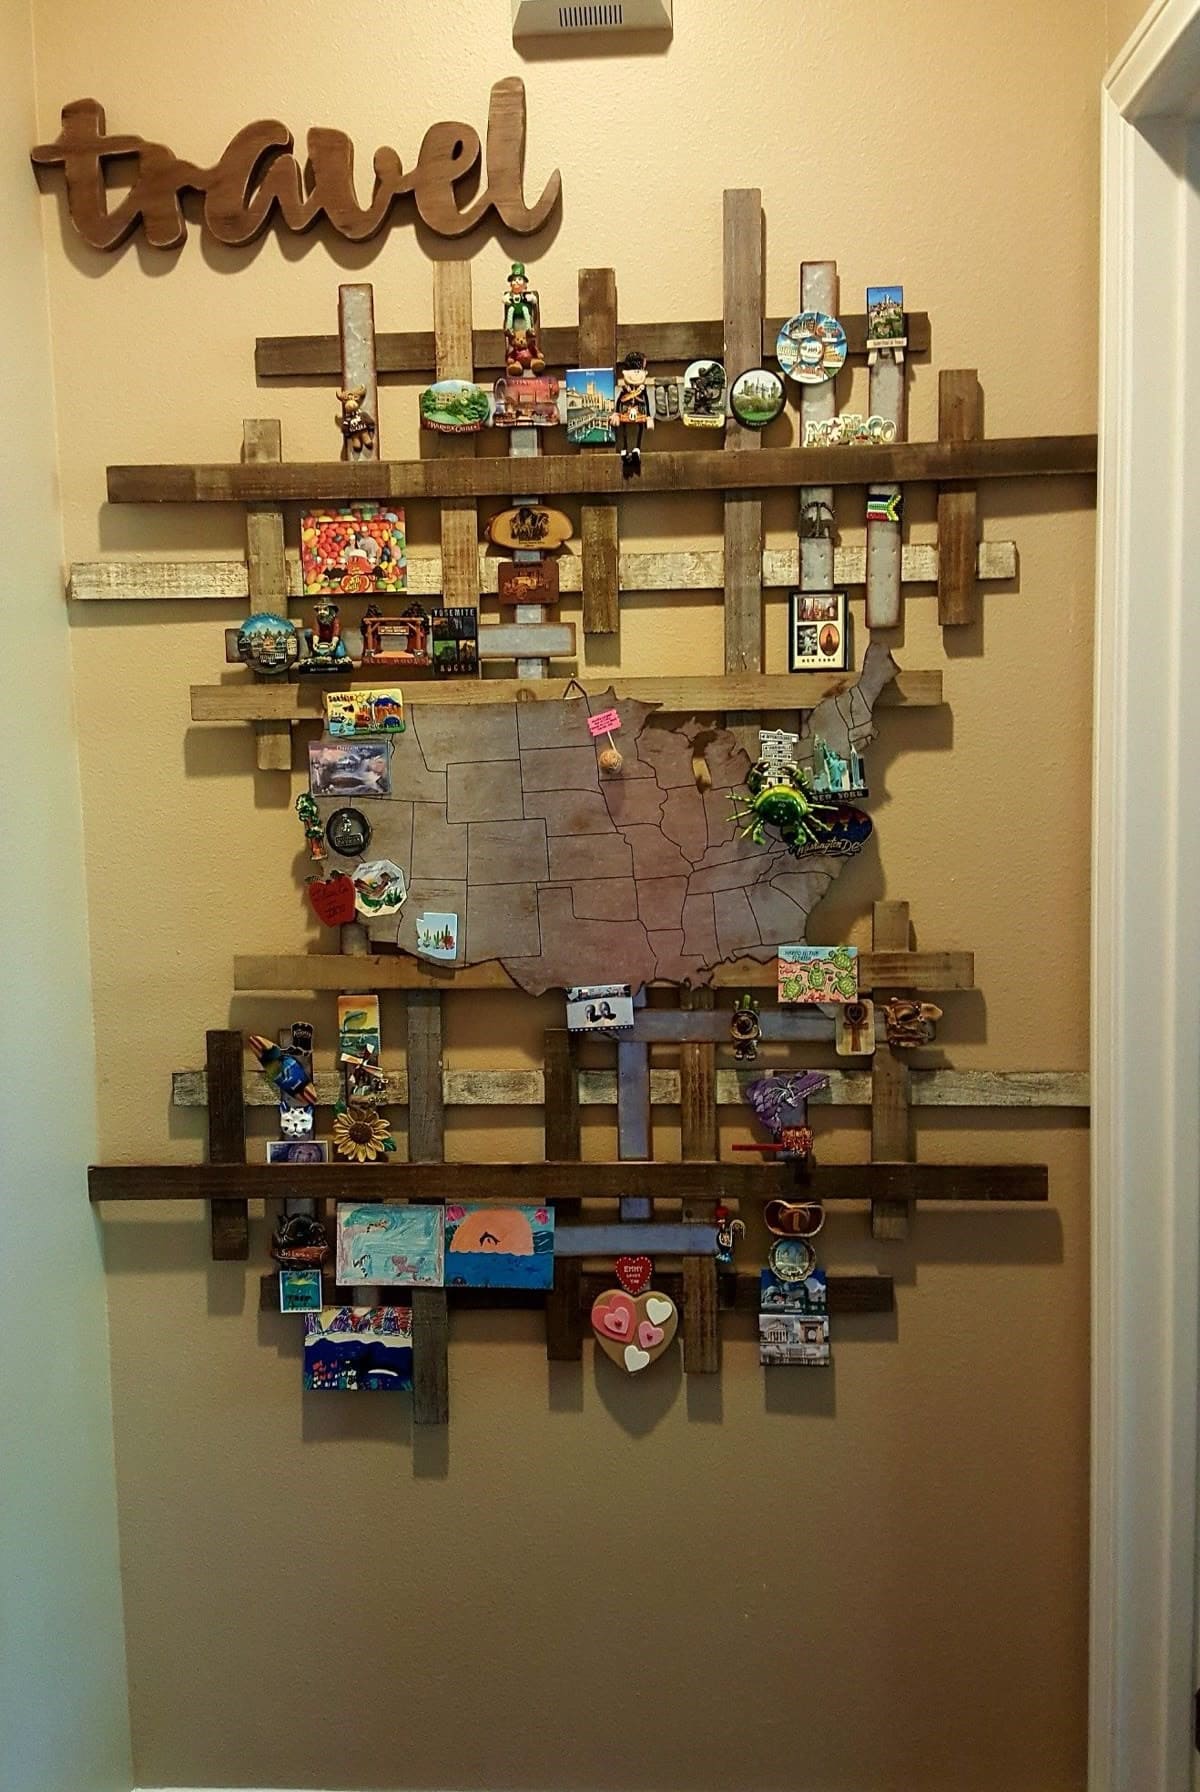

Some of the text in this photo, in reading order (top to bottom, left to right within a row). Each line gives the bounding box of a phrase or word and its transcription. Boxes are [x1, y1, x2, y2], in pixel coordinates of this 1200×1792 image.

[31, 76, 562, 252] travel
[433, 608, 475, 617] YOSEMITE
[440, 664, 473, 672] ROCKS
[811, 790, 864, 801] NEW YORK
